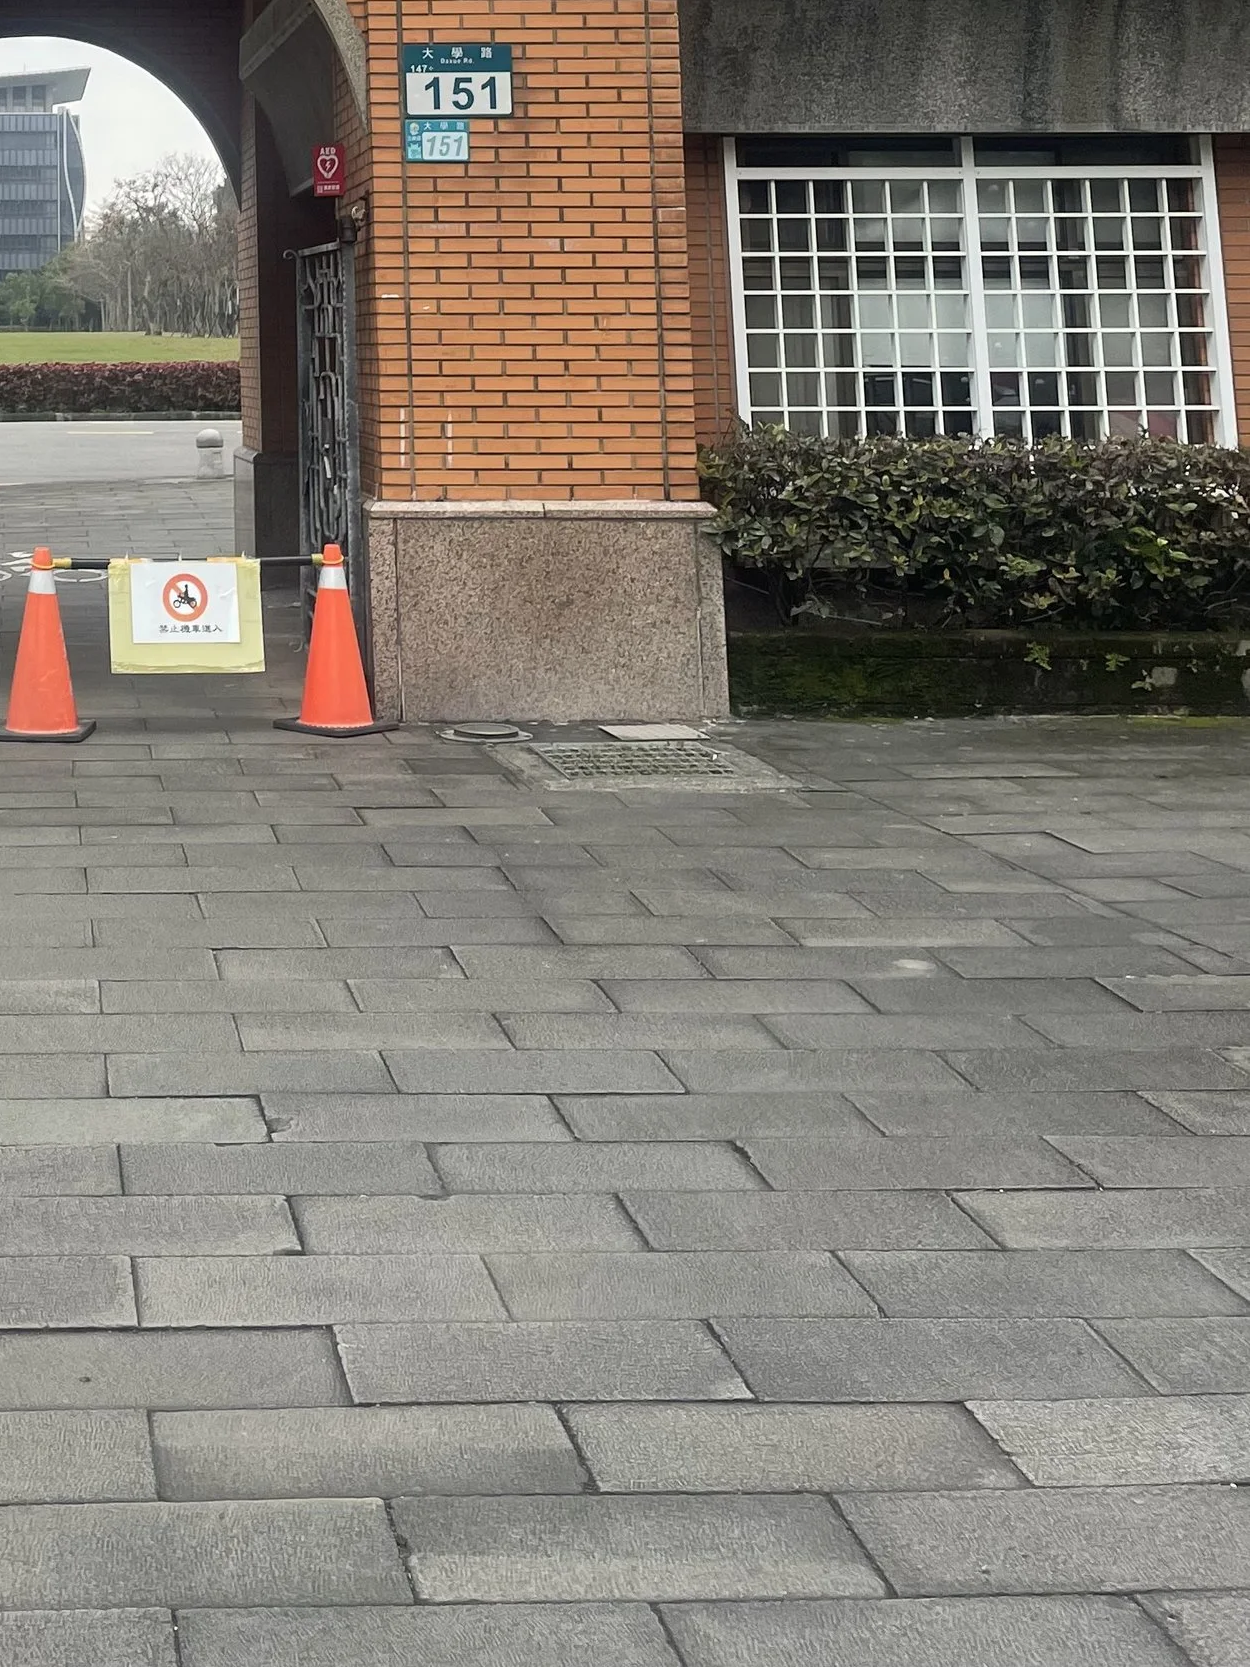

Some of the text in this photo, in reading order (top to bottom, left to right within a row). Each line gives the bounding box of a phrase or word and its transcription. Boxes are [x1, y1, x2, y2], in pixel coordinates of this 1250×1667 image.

[422, 47, 493, 59] 大學路
[424, 76, 497, 110] 151
[319, 146, 336, 155] AED
[426, 135, 463, 157] 151
